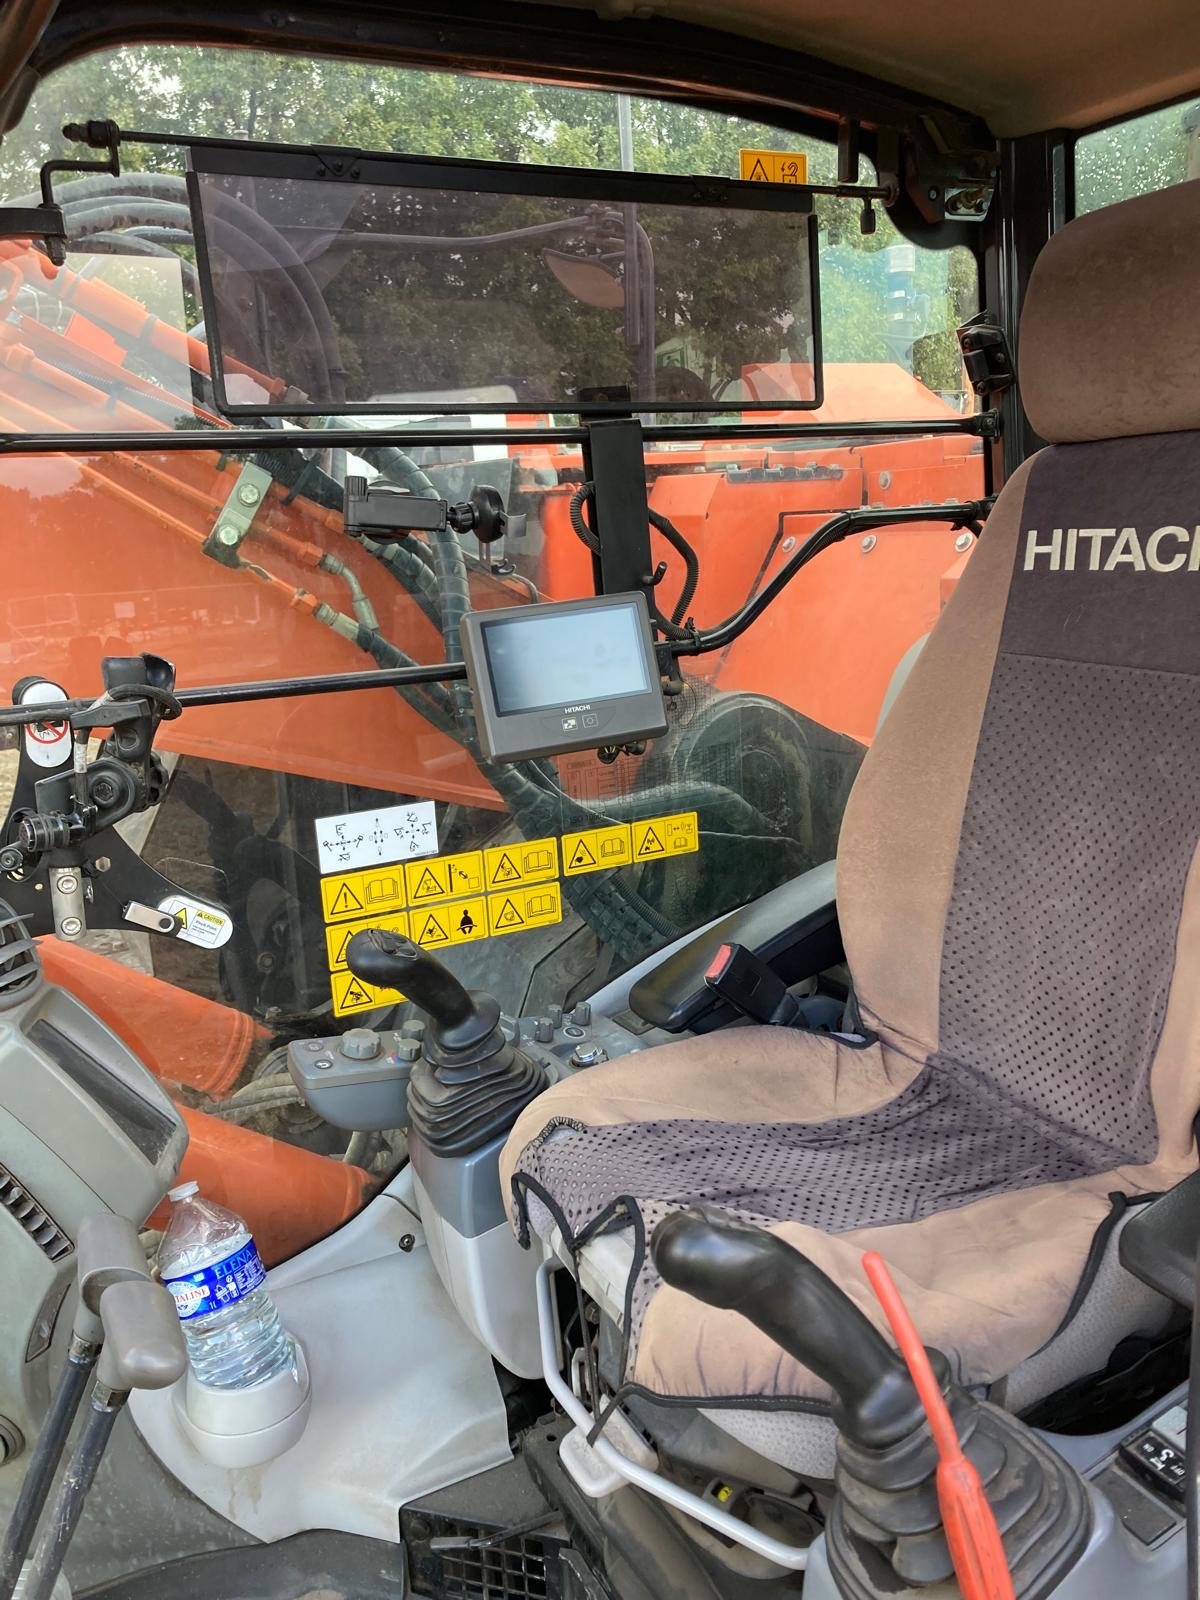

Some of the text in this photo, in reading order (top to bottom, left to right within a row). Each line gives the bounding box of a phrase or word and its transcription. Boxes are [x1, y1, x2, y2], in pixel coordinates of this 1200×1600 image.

[564, 704, 591, 714] HITACHI
[203, 913, 224, 926] CAUTION
[214, 1249, 253, 1280] ELENA
[175, 1287, 208, 1304] TALINE
[1142, 1443, 1155, 1453] ON
[1170, 1464, 1186, 1476] OFF
